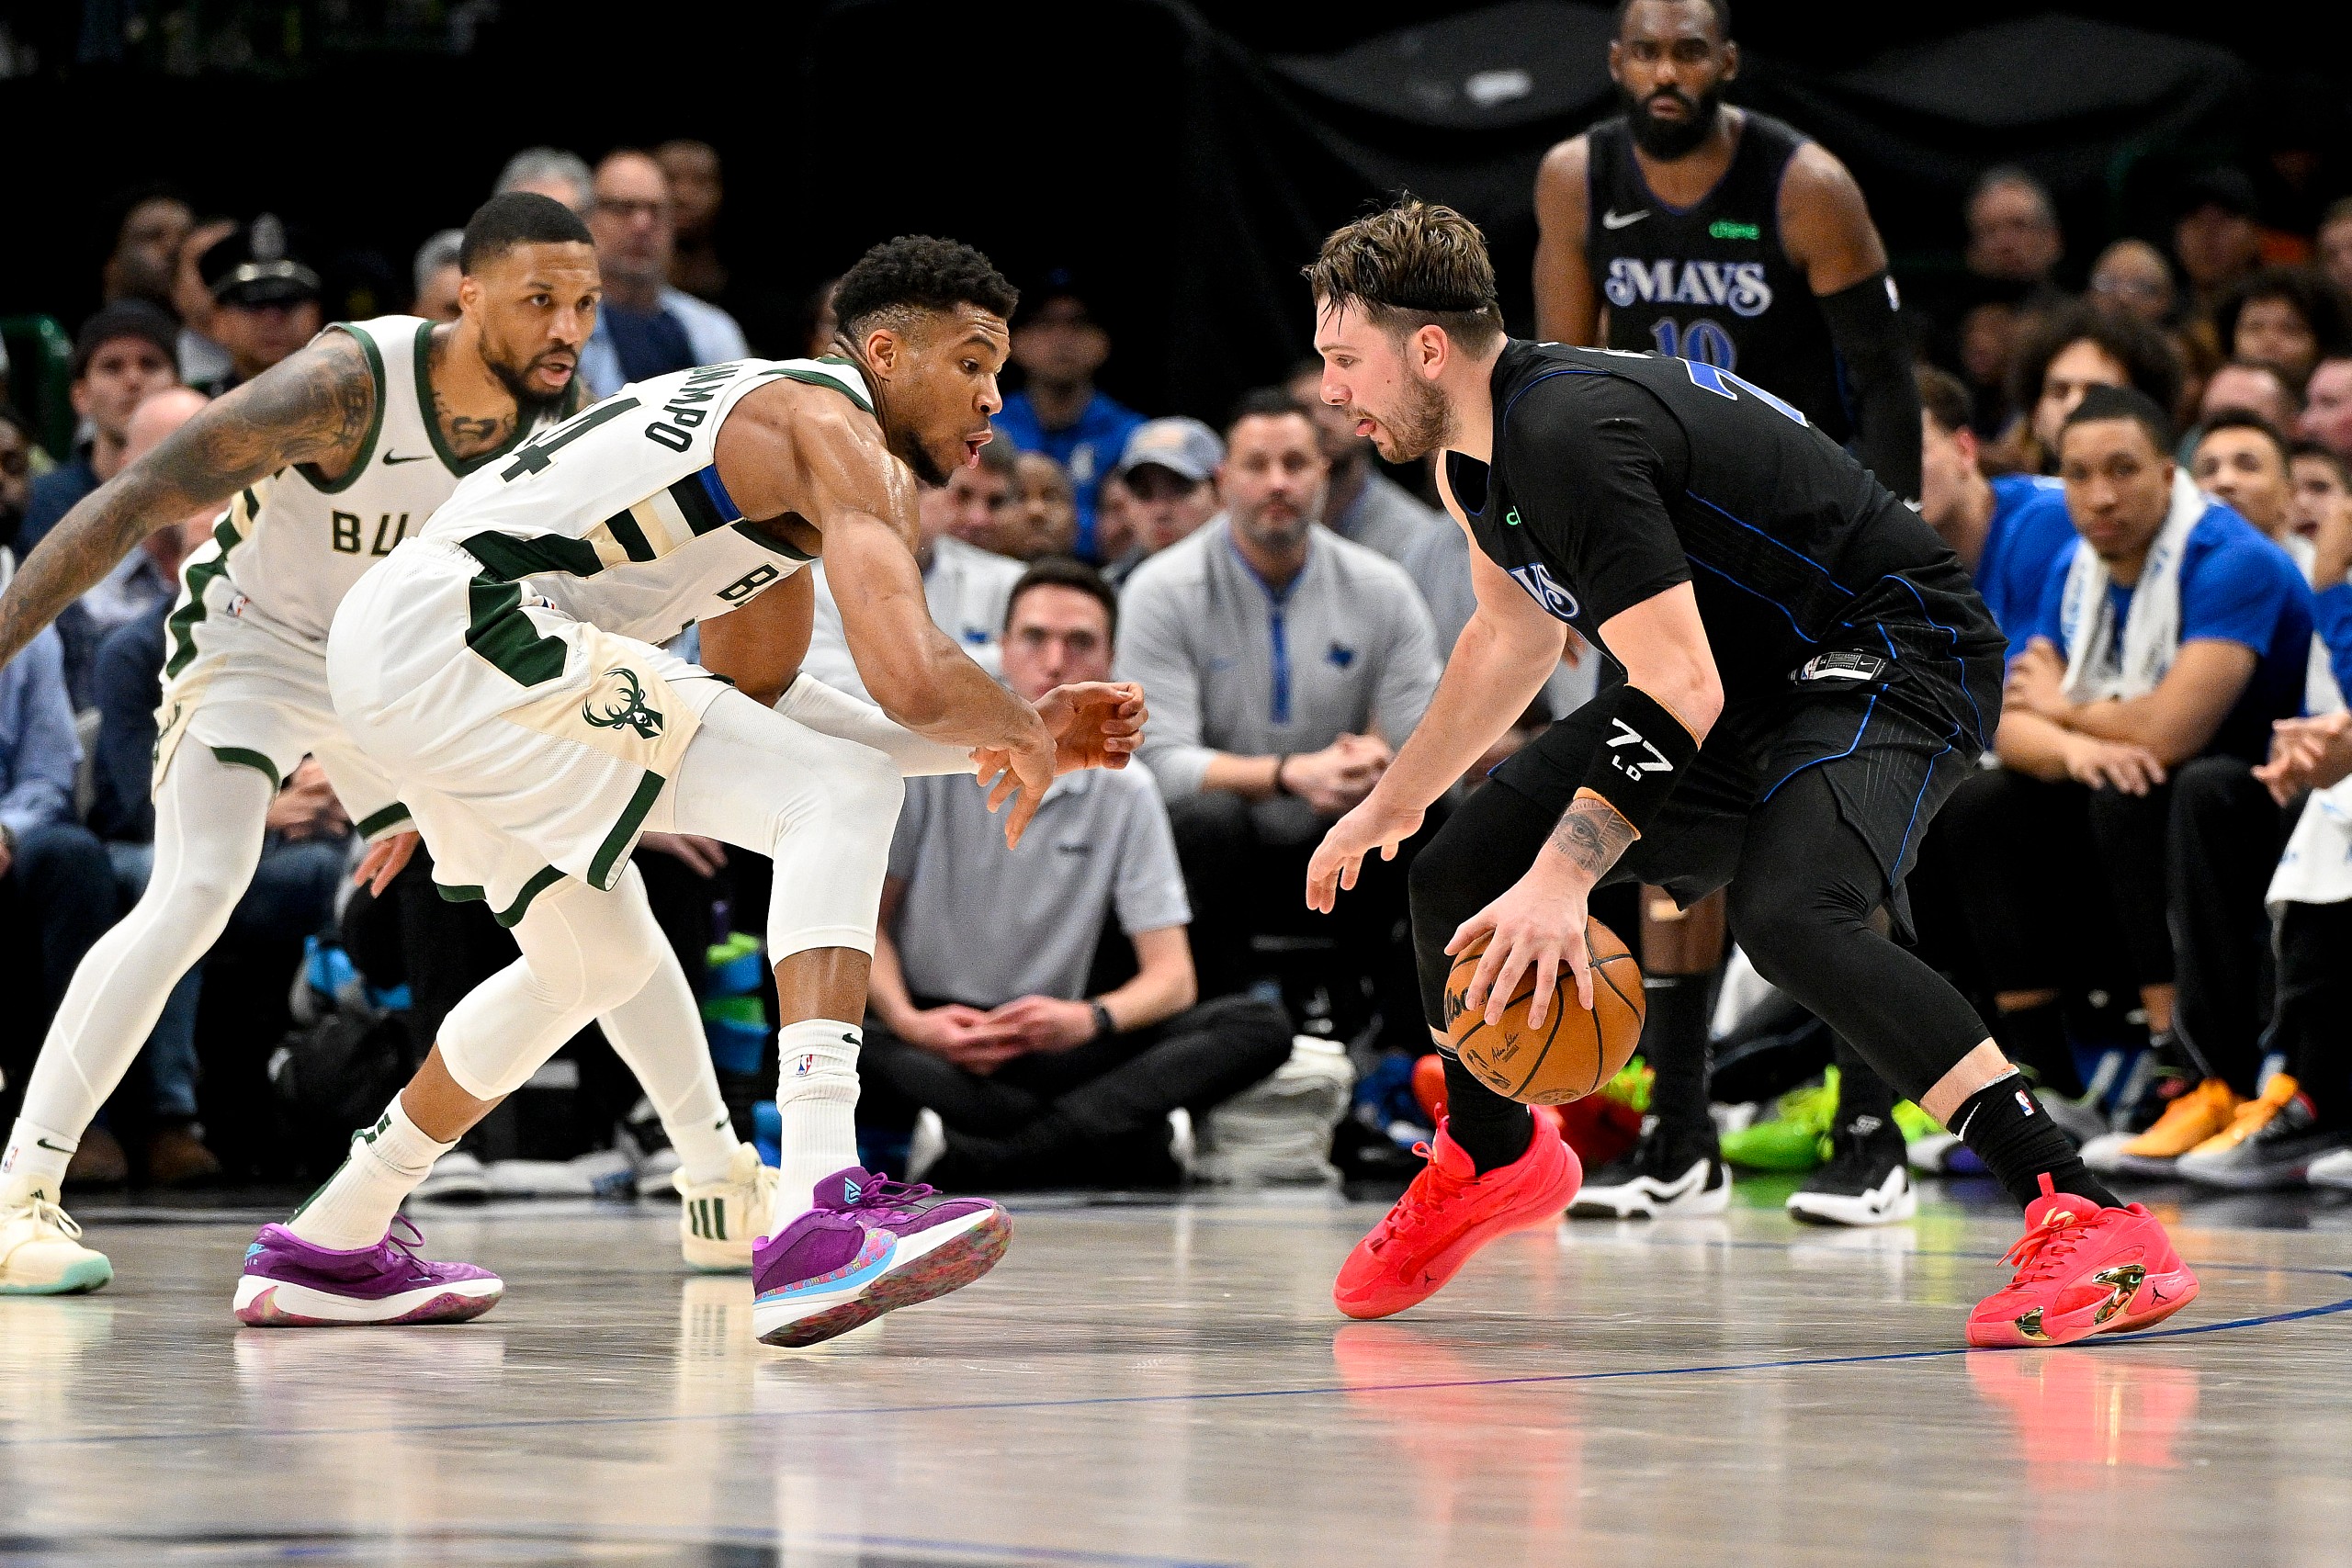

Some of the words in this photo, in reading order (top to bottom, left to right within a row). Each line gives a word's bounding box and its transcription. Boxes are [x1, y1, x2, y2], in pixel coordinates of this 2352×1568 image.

[1604, 257, 1773, 317] MAVS
[1650, 316, 1737, 373] 10
[1606, 717, 1674, 772] 77
